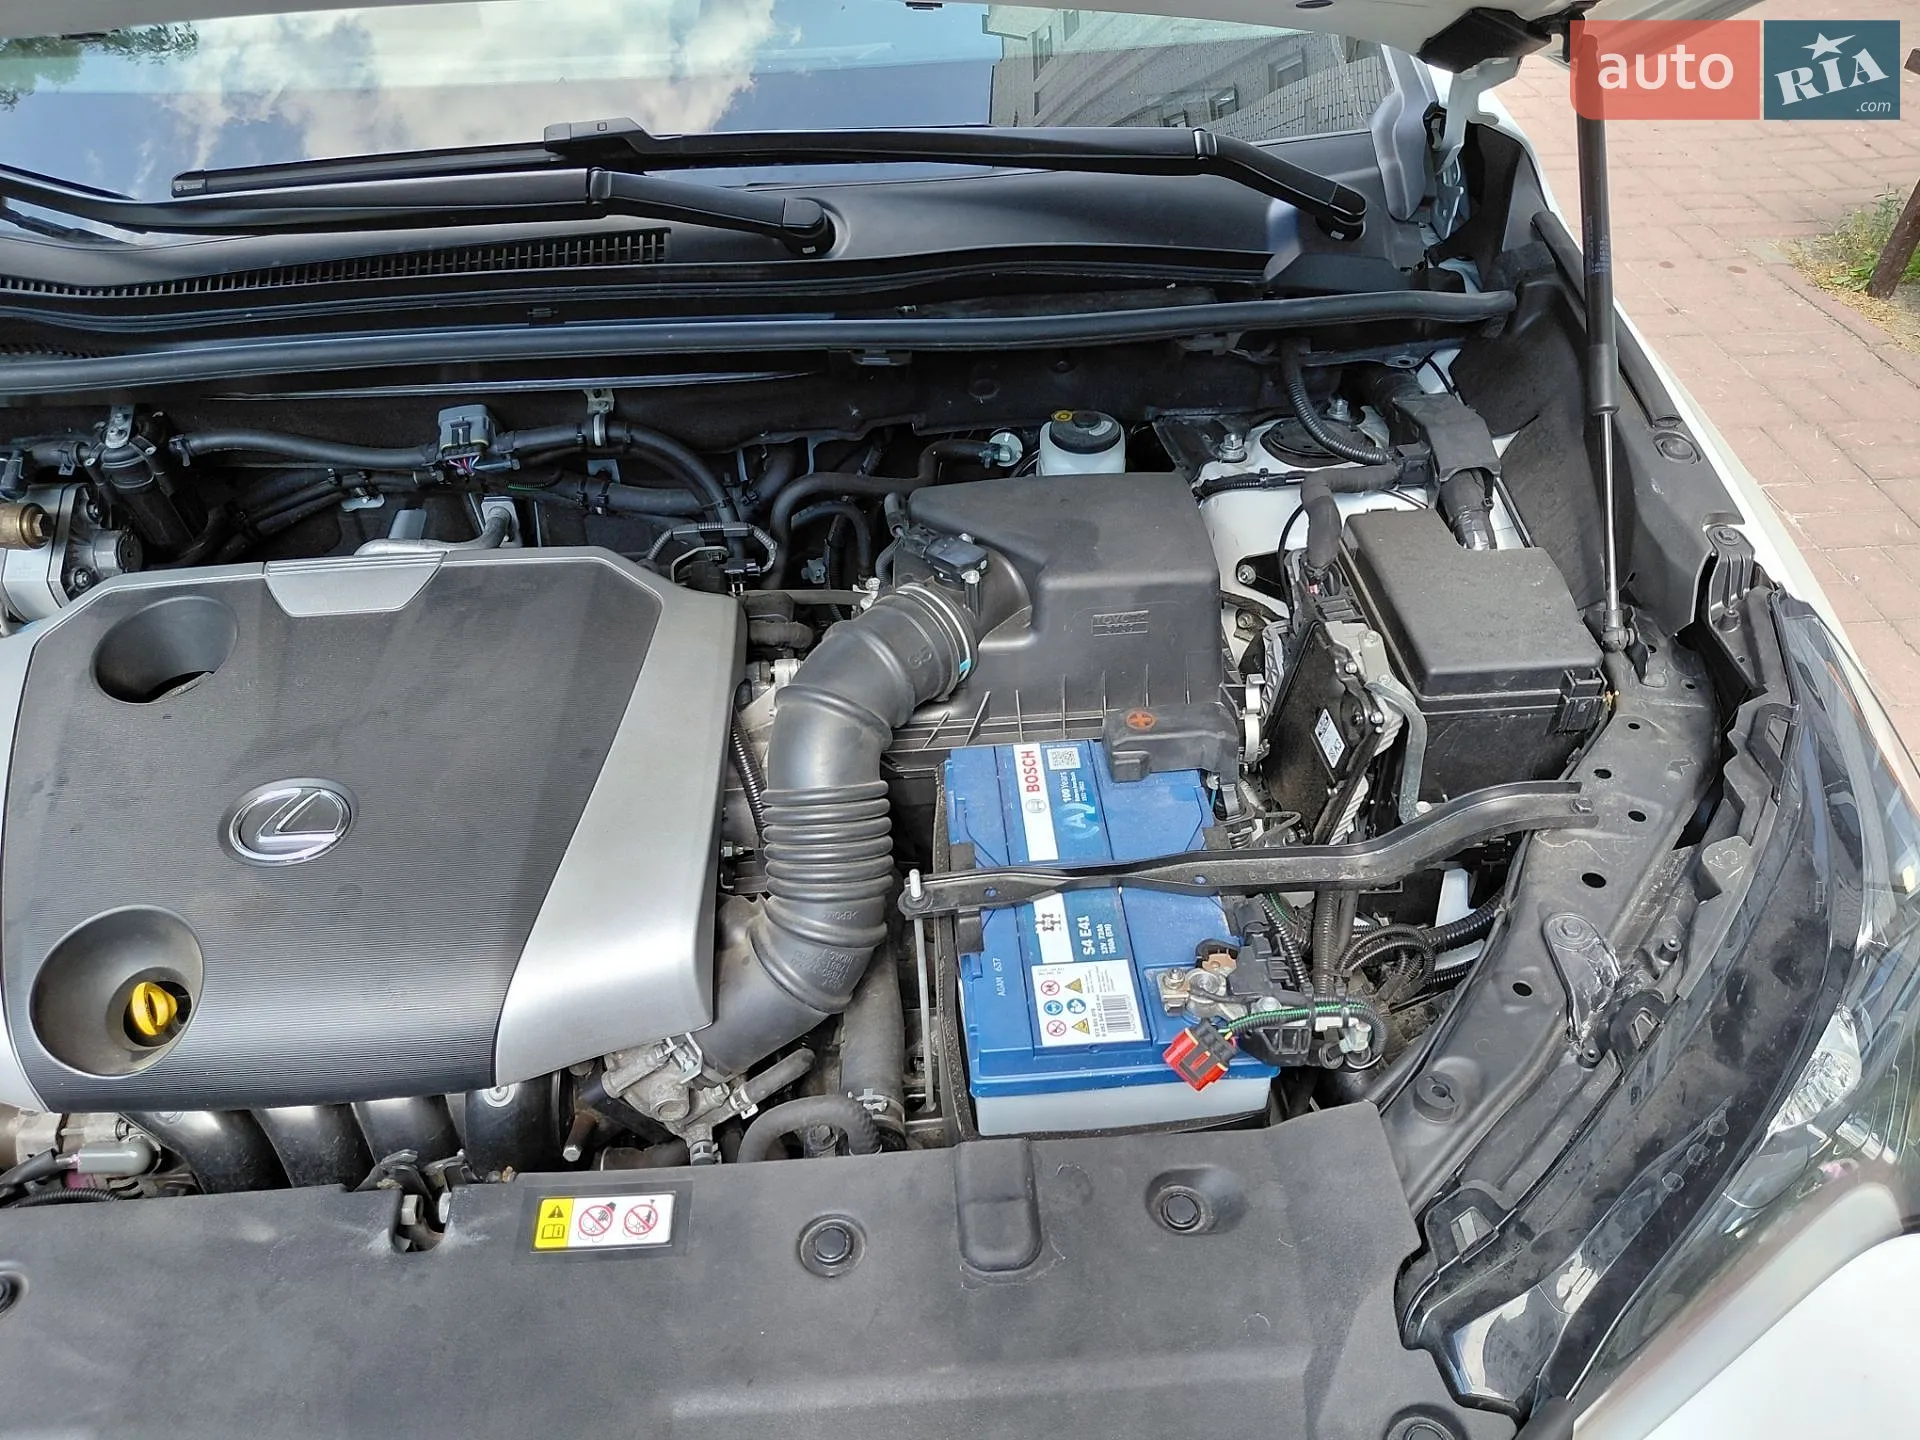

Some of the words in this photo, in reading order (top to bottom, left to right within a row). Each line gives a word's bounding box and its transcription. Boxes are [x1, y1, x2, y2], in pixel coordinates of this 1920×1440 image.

[1020, 750, 1040, 793] BOSCH
[1076, 915, 1092, 937] E41
[1080, 938, 1096, 956] S4
